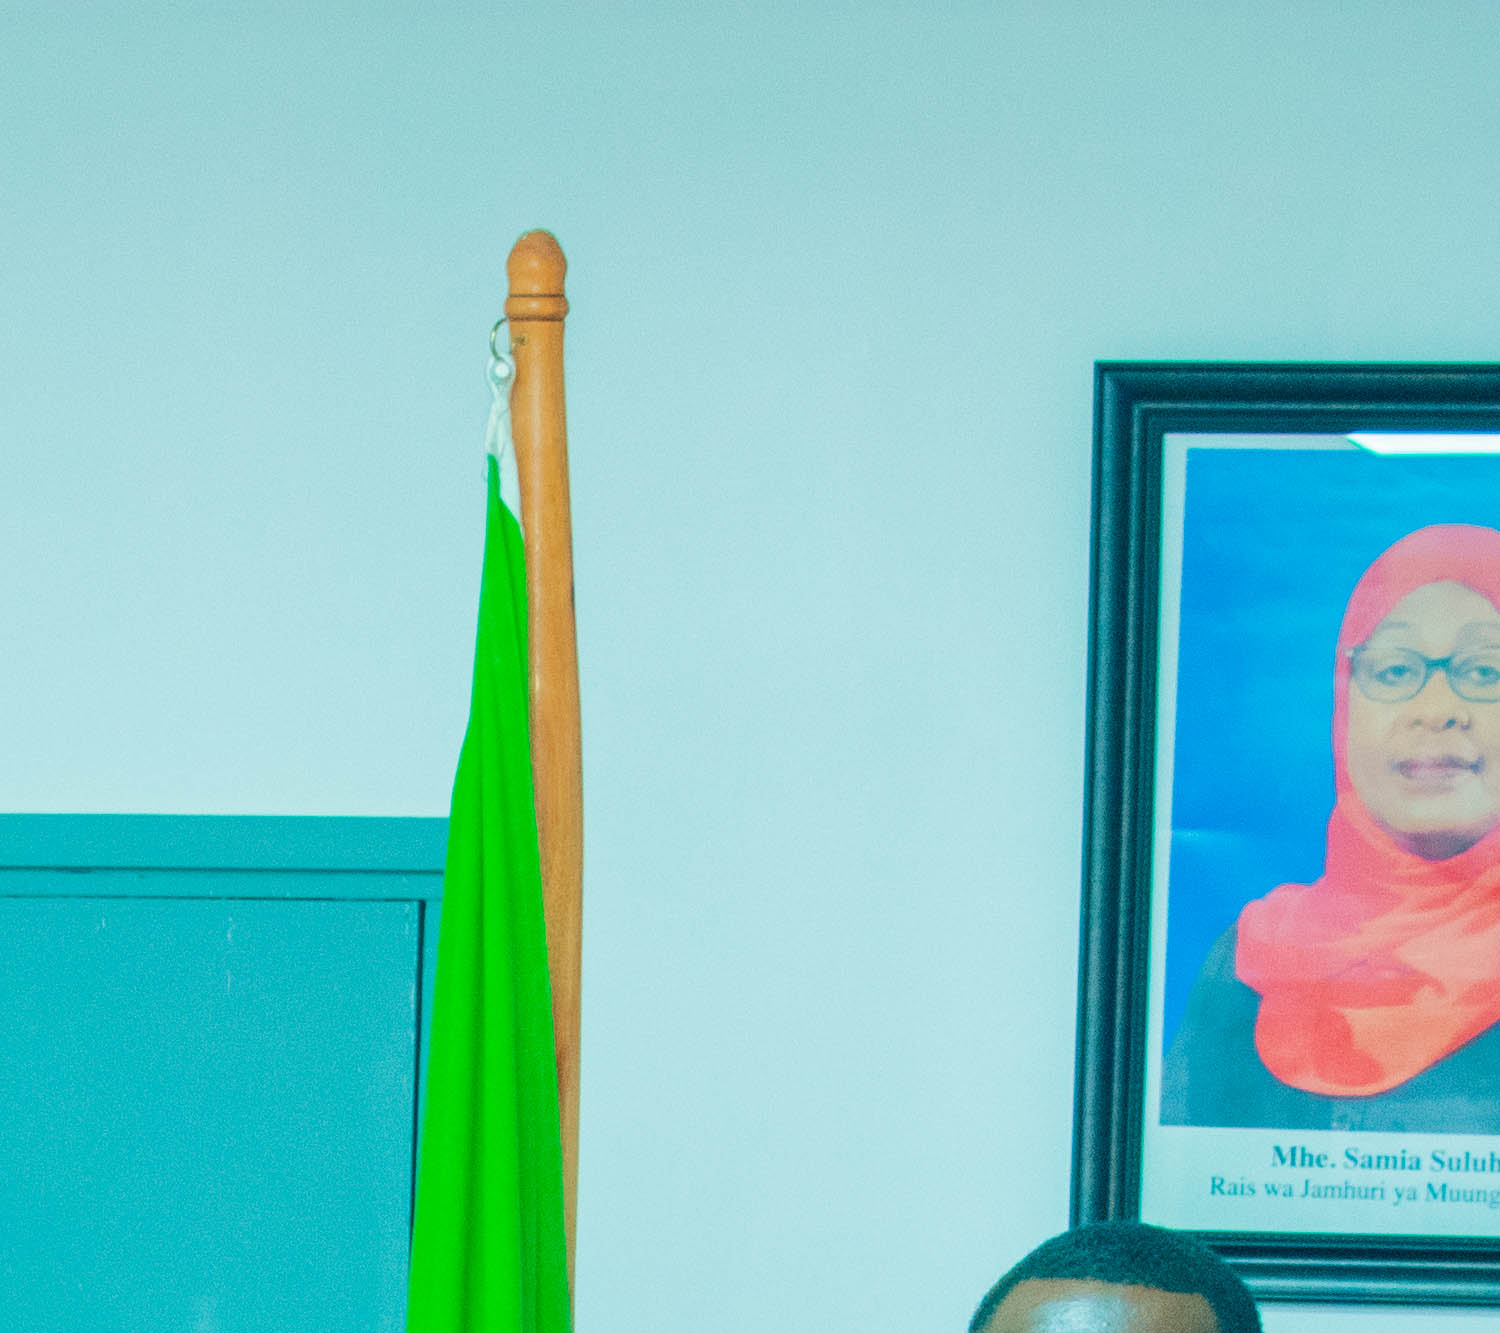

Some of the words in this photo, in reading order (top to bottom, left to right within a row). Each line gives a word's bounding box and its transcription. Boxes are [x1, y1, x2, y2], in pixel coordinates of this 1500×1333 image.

[1270, 1145, 1337, 1169] Mhe.
[1343, 1146, 1422, 1172] Samia
[1209, 1177, 1257, 1197] Rais
[1263, 1183, 1294, 1199] wa
[1300, 1179, 1386, 1200] Jamhuri
[1391, 1186, 1418, 1207] ya
